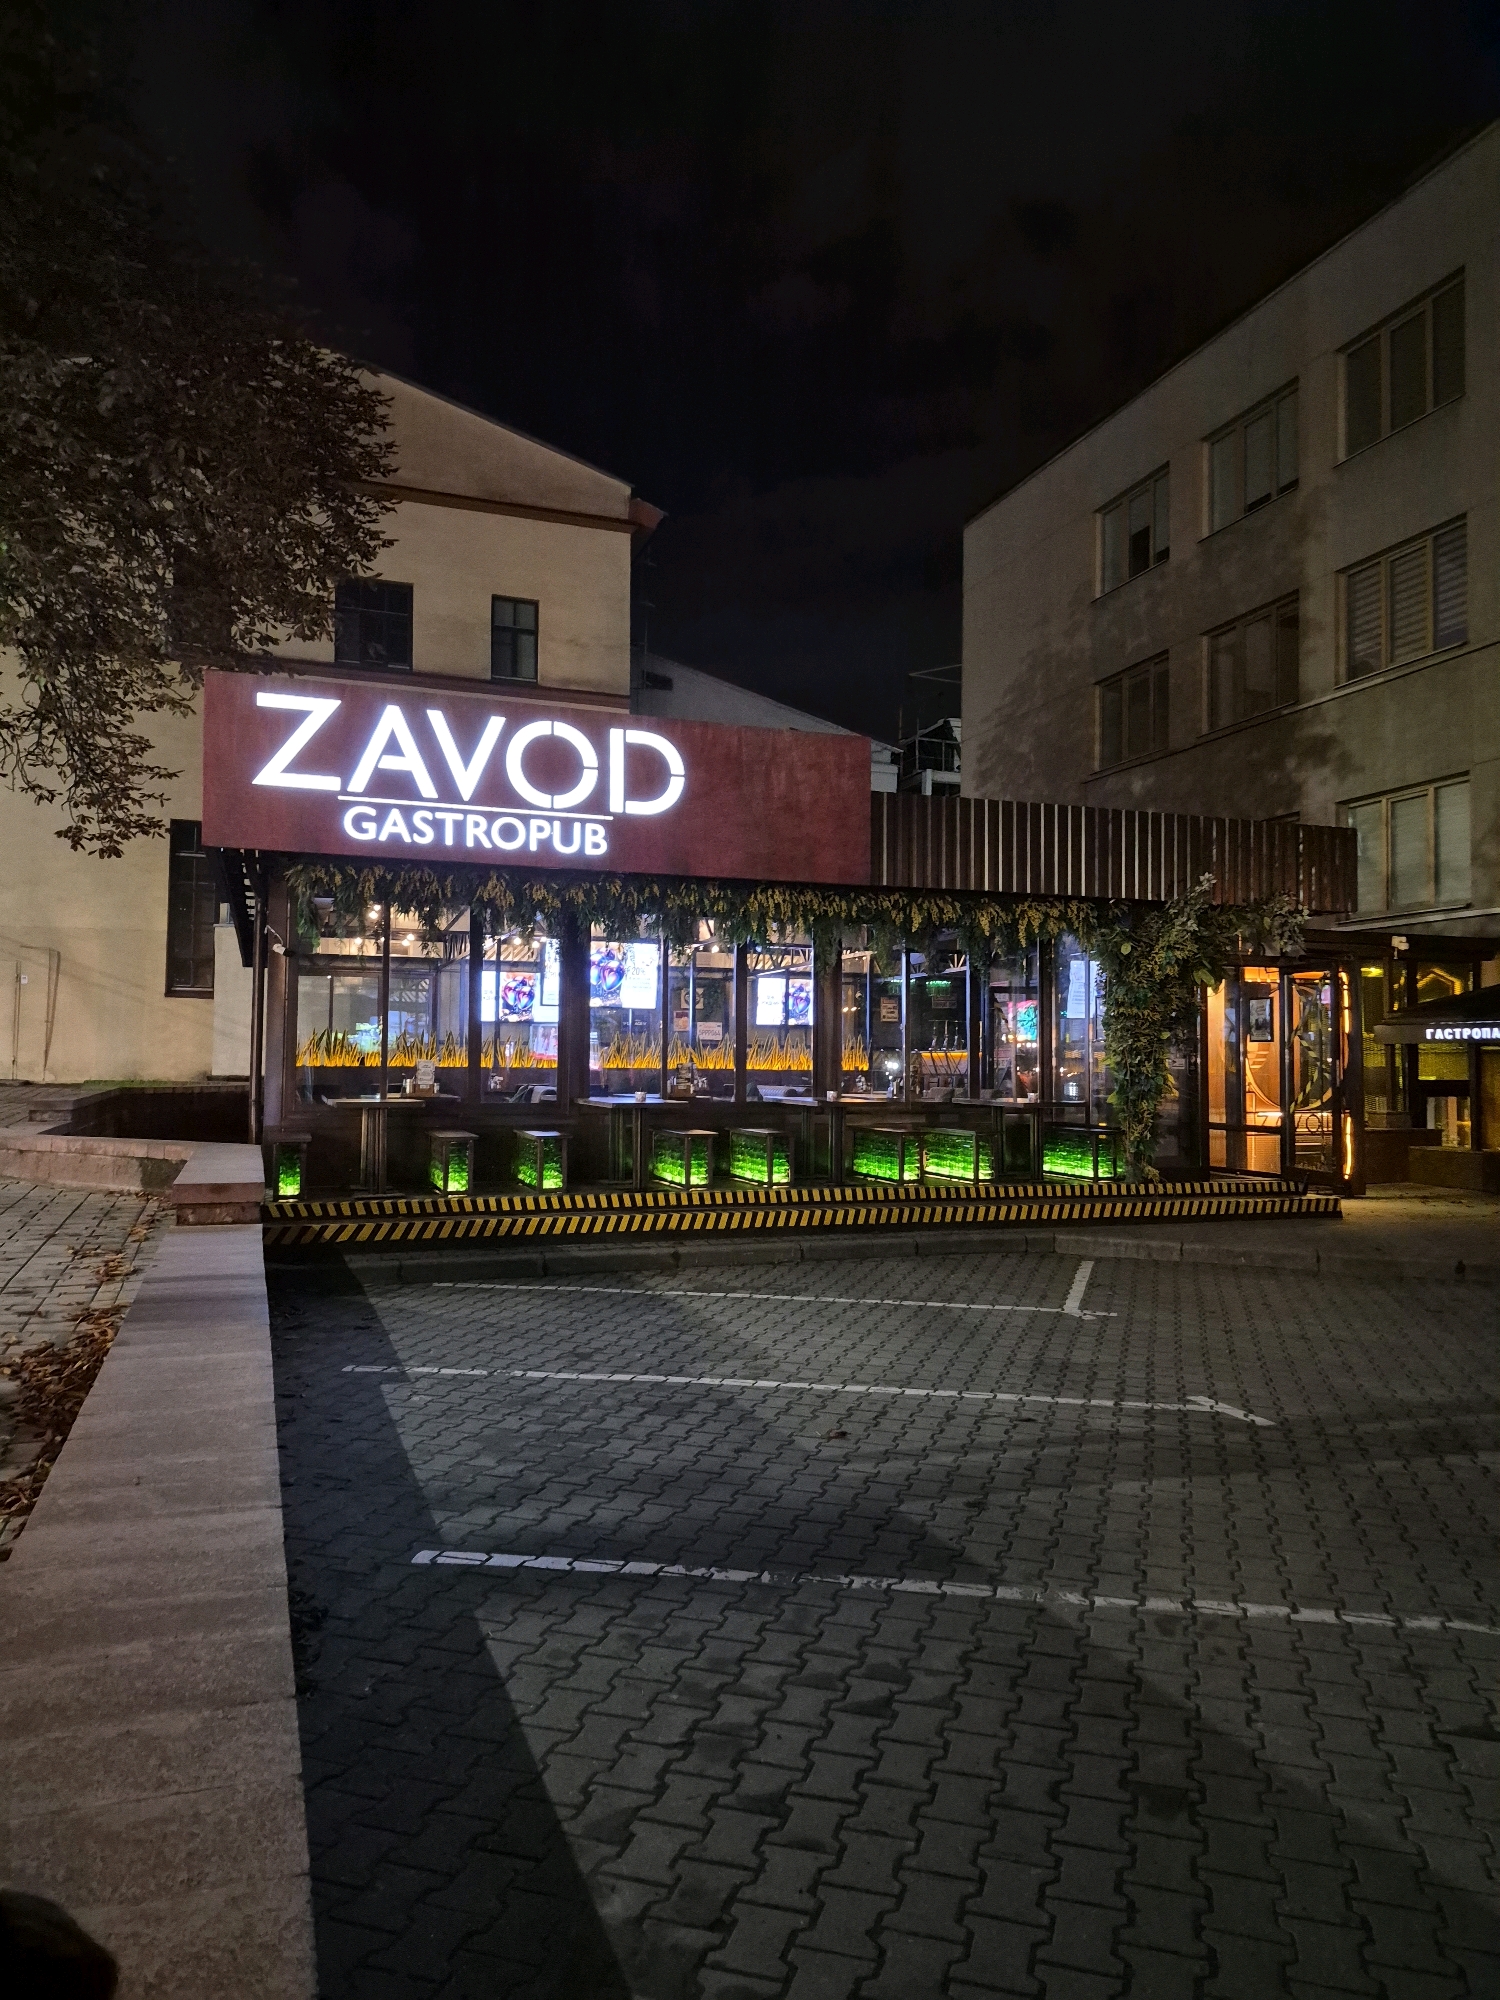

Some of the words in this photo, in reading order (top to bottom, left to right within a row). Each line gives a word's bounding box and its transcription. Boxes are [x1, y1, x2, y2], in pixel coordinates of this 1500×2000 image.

[251, 691, 686, 817] ZAVOD
[343, 805, 609, 857] GASTROPUB
[1425, 1027, 1500, 1040] ГАСТРОПА
